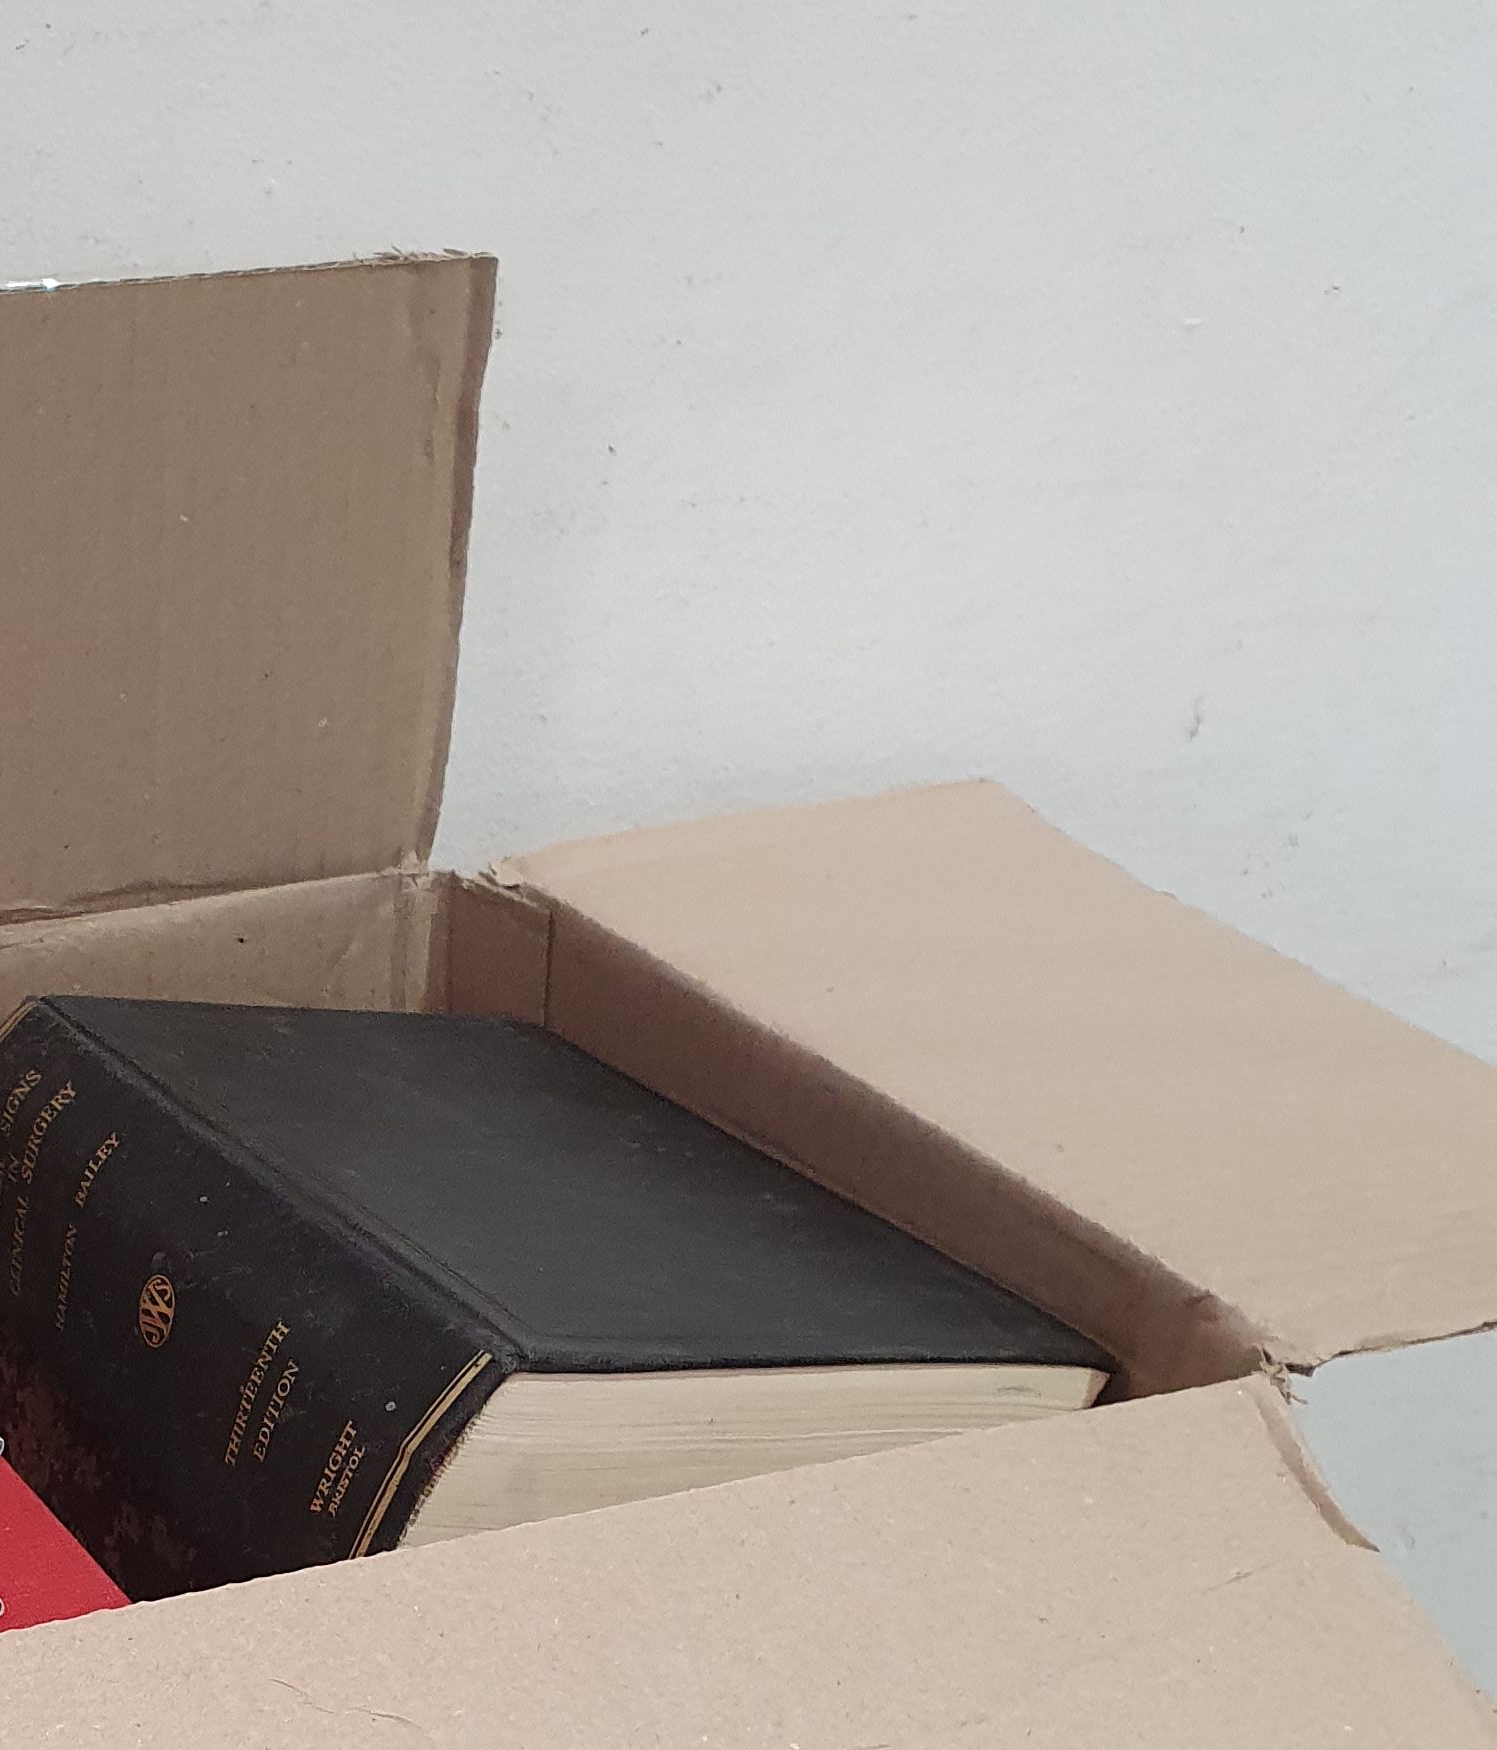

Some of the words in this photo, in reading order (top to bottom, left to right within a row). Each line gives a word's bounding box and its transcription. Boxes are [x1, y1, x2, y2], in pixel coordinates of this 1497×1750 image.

[0, 1069, 42, 1137] SIGNS
[21, 1080, 78, 1185] SURGERY
[55, 1222, 77, 1331] HAMILTON
[74, 1131, 120, 1208] BAILEY
[224, 1320, 291, 1467] THIRTEENTH
[254, 1358, 300, 1463] EDITION
[310, 1419, 357, 1513] WRIGHT
[328, 1444, 367, 1518] BRISTOL
